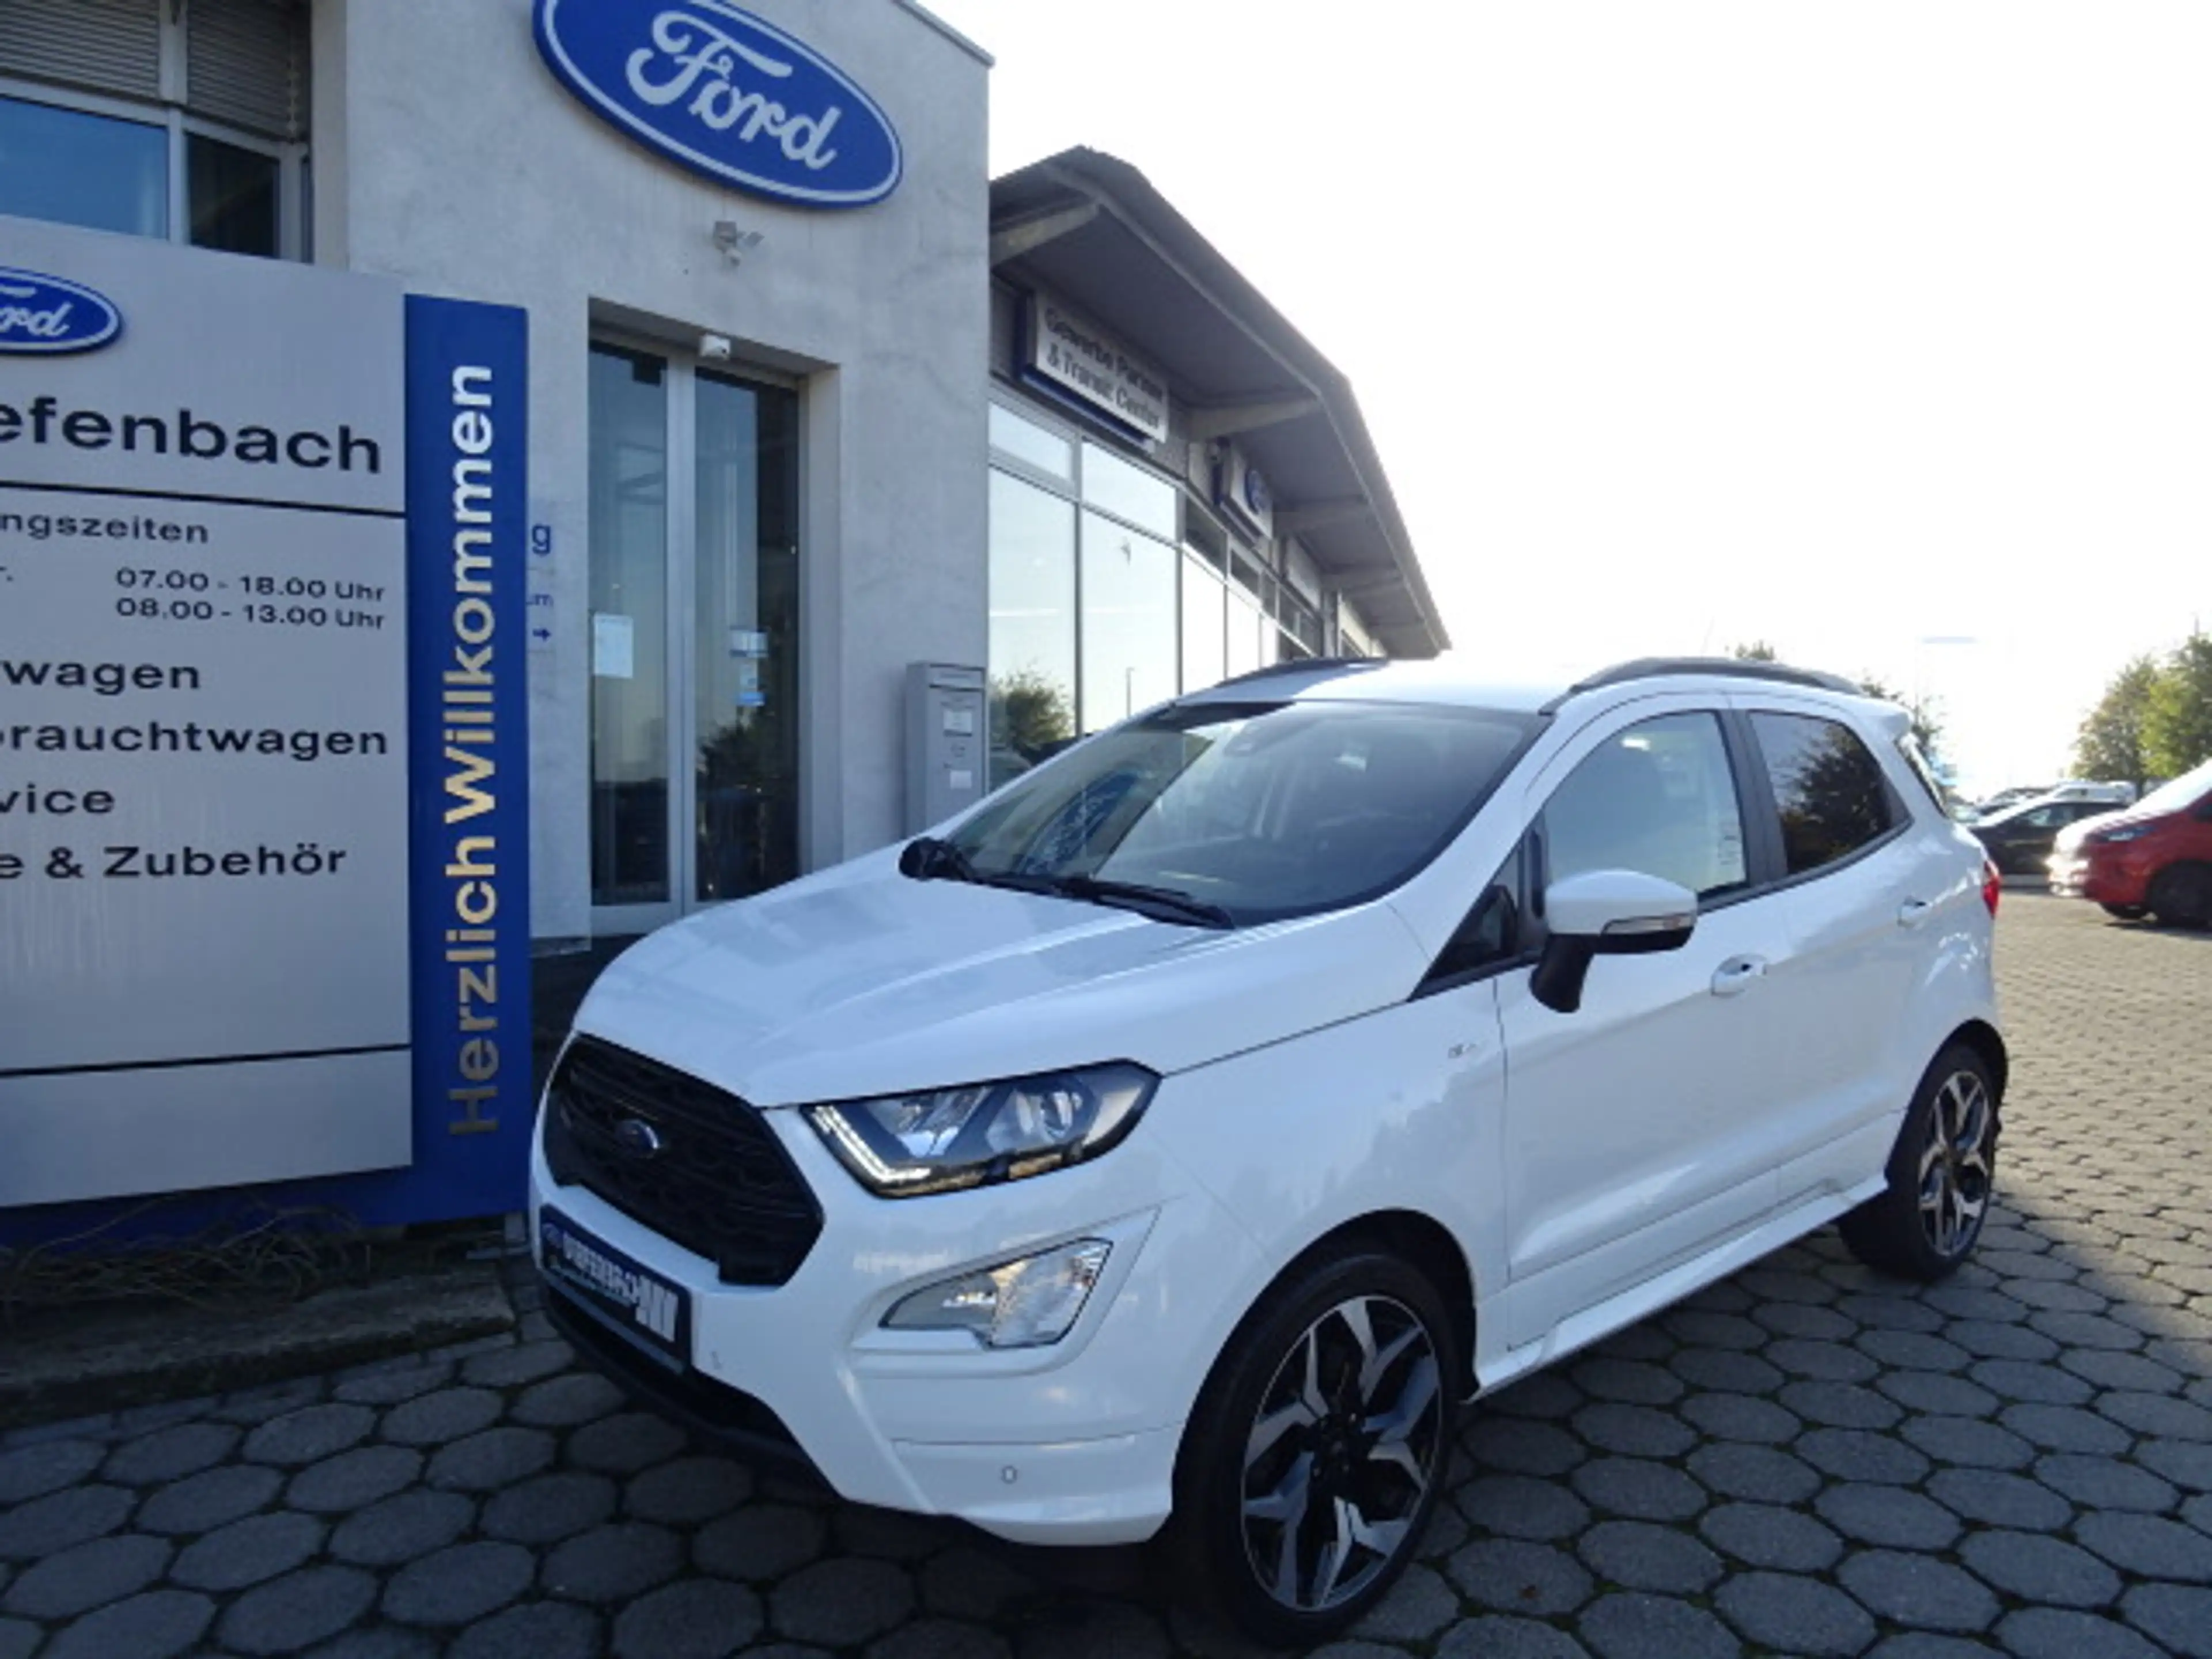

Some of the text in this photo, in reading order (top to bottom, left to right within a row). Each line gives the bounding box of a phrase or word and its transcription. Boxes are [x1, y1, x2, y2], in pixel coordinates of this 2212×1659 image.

[624, 10, 842, 170] Ford
[0, 283, 73, 337] rd
[115, 566, 210, 593] 07.00
[240, 575, 327, 599] 18.00
[335, 581, 385, 602] Uhr
[115, 596, 214, 621] 08.00
[242, 604, 328, 628] 13.00
[335, 608, 385, 630] Uhr
[2, 660, 201, 696] wagen
[0, 720, 388, 762] rauchtwagen
[444, 365, 499, 1135] Herzlich Willkommen
[44, 846, 85, 880] &
[103, 843, 347, 879] Zubehör
